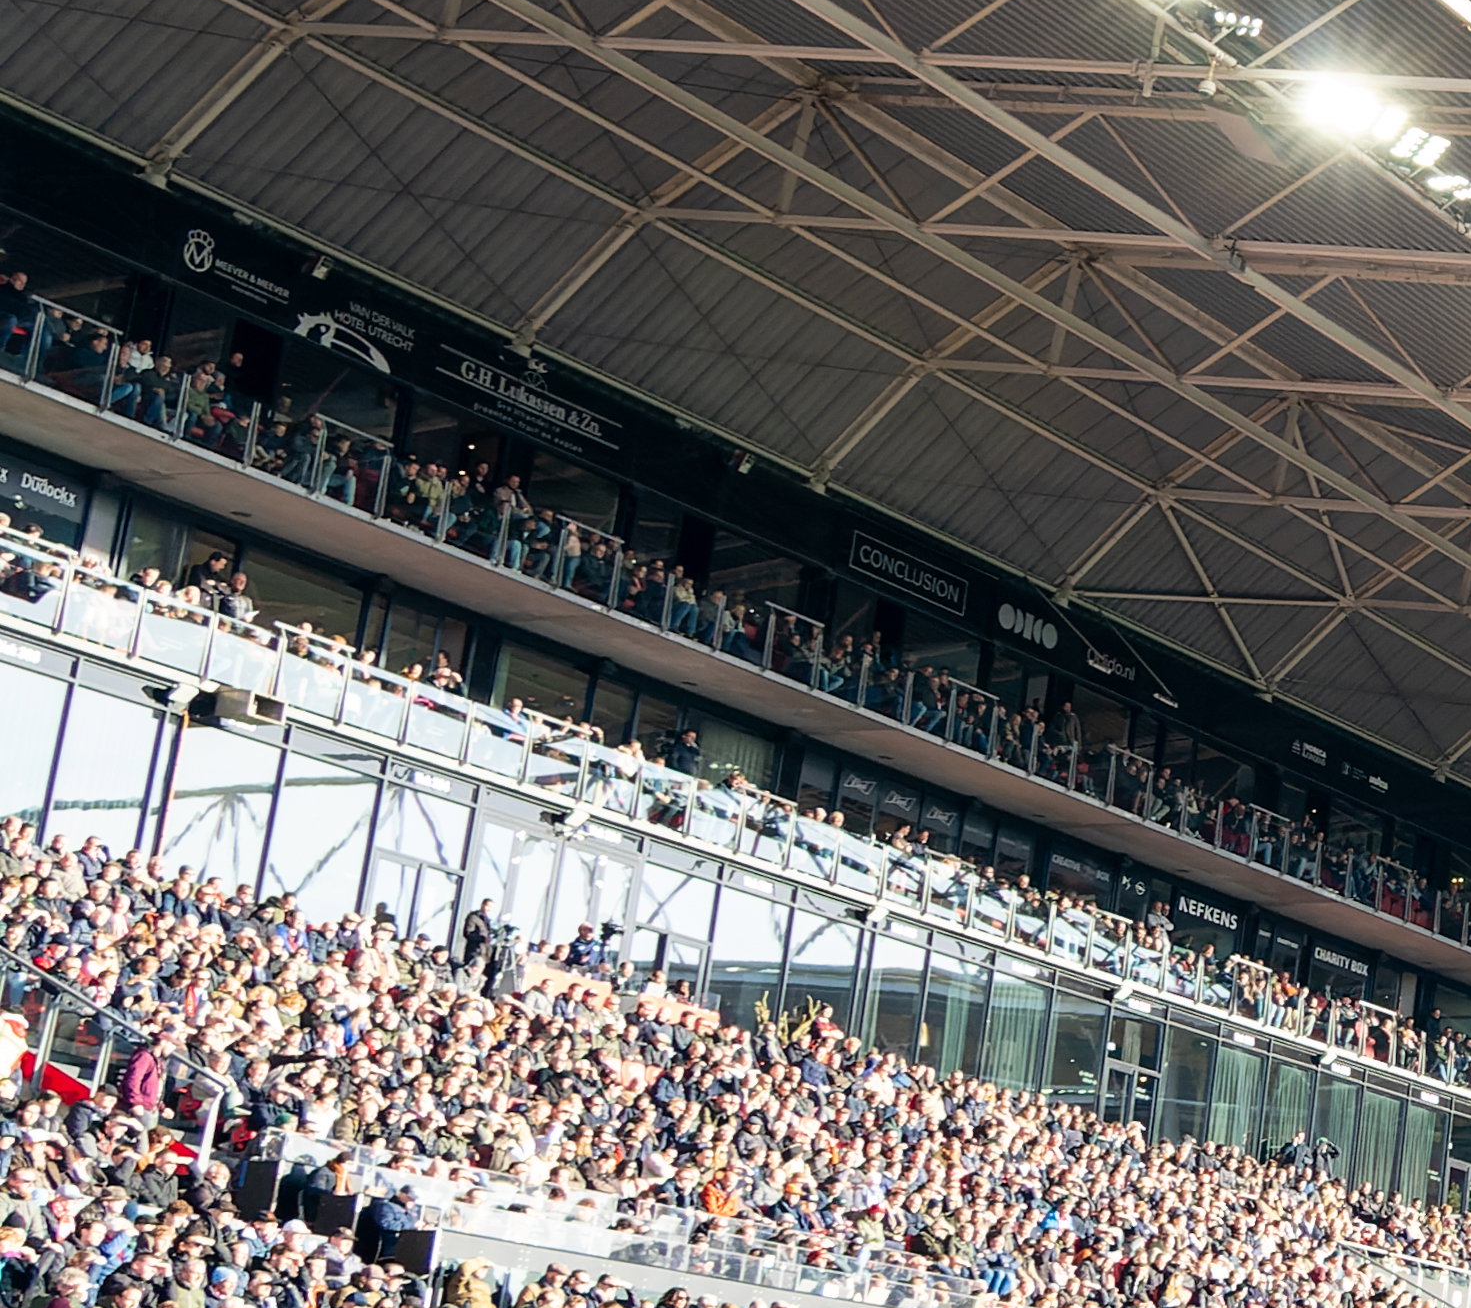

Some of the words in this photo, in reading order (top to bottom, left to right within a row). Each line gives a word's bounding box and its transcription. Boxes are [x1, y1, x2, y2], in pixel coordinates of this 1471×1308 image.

[334, 309, 366, 333] HOTEL
[368, 326, 415, 352] UTRECHT
[460, 361, 495, 390] G.H.
[859, 544, 960, 603] CONCLUSION
[1178, 896, 1239, 930] NEFKENS
[1314, 947, 1350, 970] CHARITY
[1351, 960, 1369, 977] BOX
